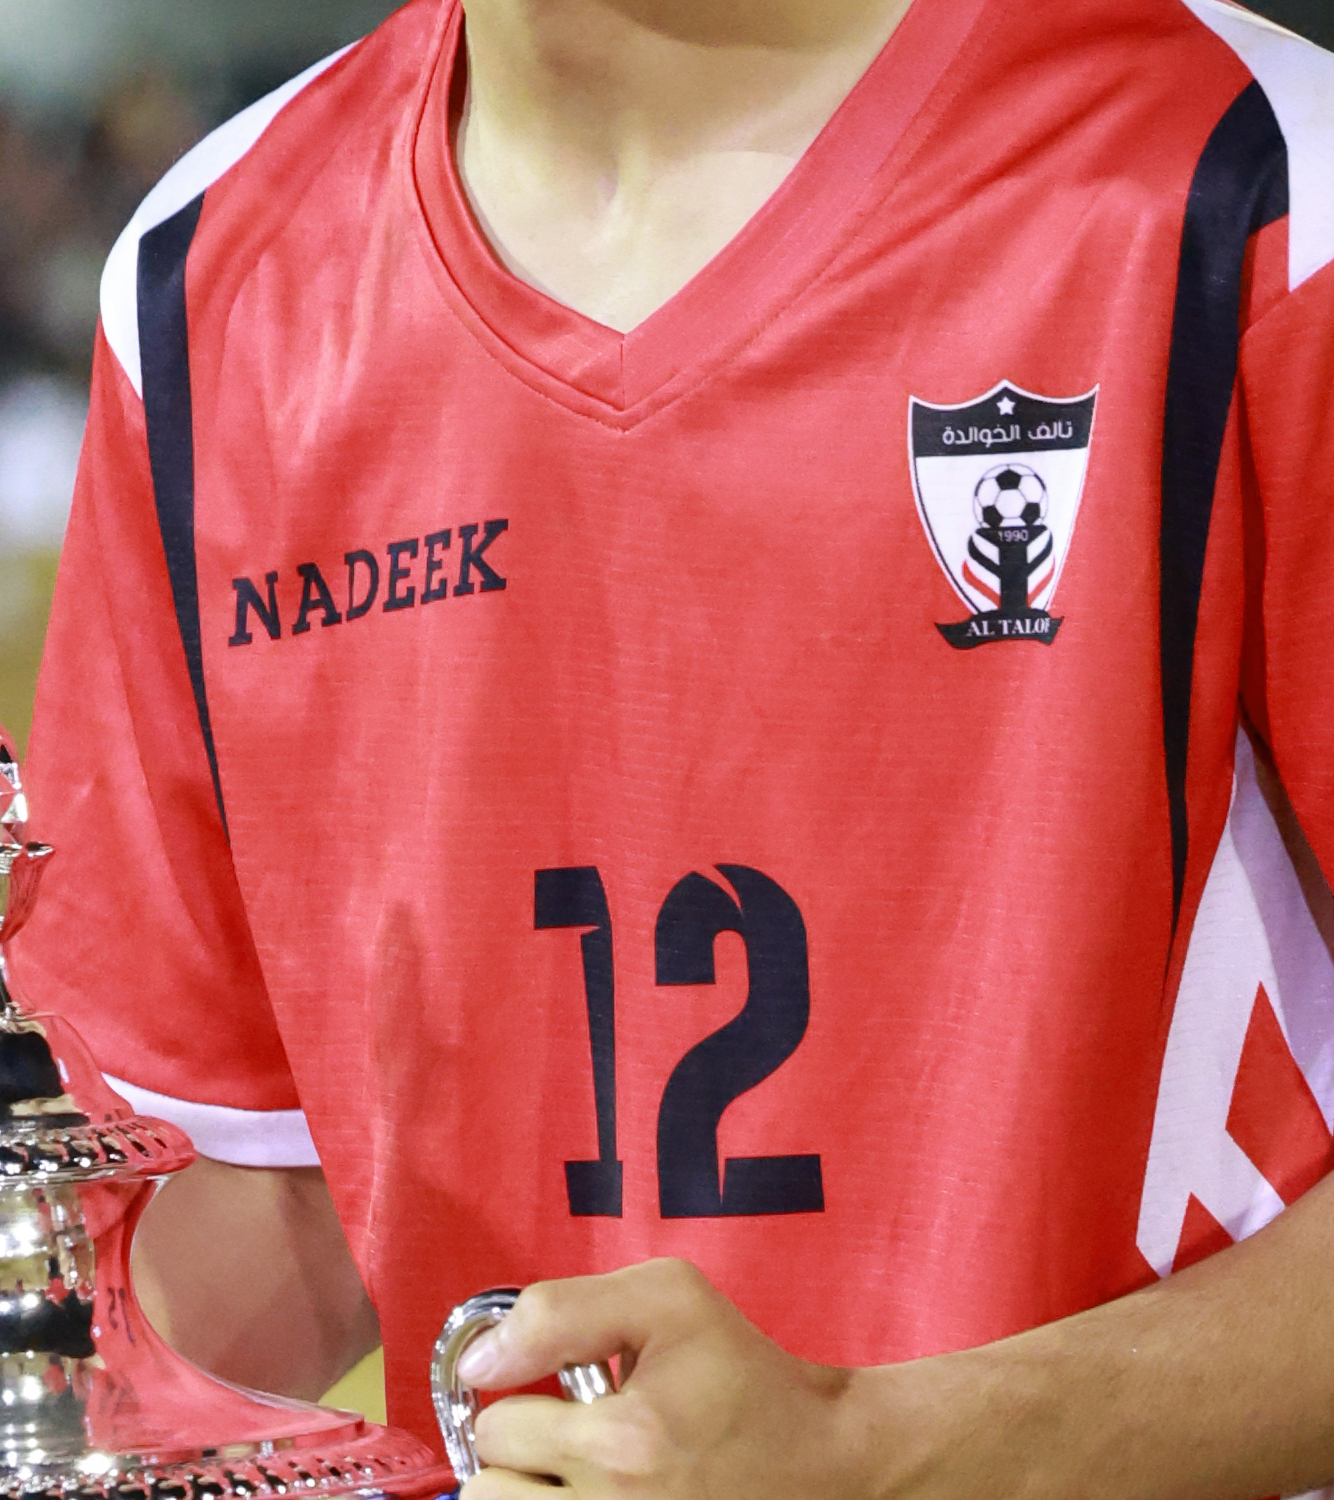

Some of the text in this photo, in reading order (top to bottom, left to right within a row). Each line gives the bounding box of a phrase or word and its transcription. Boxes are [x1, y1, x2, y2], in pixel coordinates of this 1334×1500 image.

[942, 424, 1021, 448] الخوالدة
[998, 529, 1029, 542] 1990
[228, 518, 509, 647] NADEEK
[966, 619, 995, 637] AL
[533, 861, 825, 1219] 12
